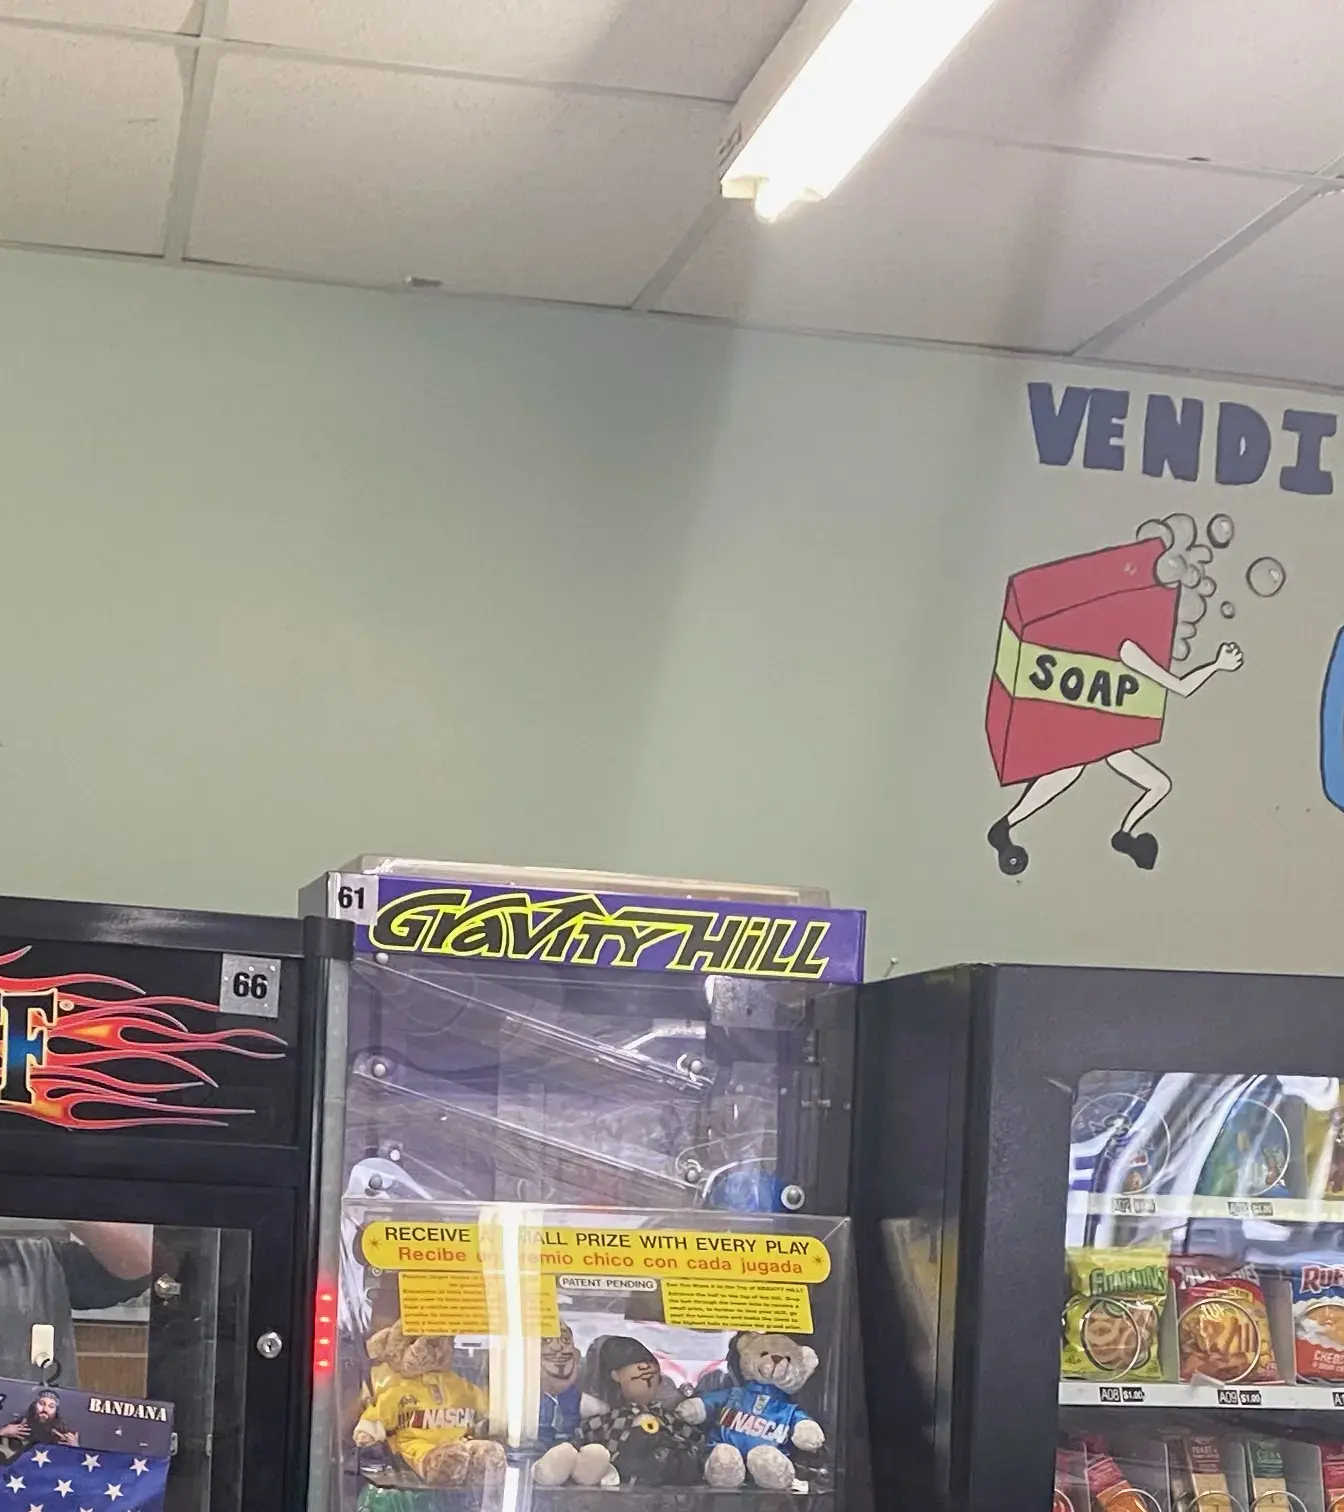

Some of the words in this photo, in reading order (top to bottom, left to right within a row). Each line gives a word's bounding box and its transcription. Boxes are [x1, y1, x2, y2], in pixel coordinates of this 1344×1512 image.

[1029, 654, 1139, 709] SOAP
[338, 886, 365, 909] 61
[233, 973, 267, 1000] 66
[385, 1227, 470, 1242] RECEIVE
[576, 1233, 631, 1248] PRIZE
[639, 1235, 687, 1250] WITH
[696, 1237, 756, 1253] EVERY
[766, 1240, 809, 1255] PLAY
[399, 1246, 466, 1261] Recibe
[583, 1251, 633, 1267] chico
[643, 1256, 677, 1268] con
[687, 1256, 731, 1271] cada
[740, 1257, 802, 1275] jugada
[562, 1278, 601, 1287] PATENT
[607, 1279, 653, 1289] PENDING
[89, 1397, 169, 1422] BANDANA
[1218, 1390, 1238, 1404] A09
